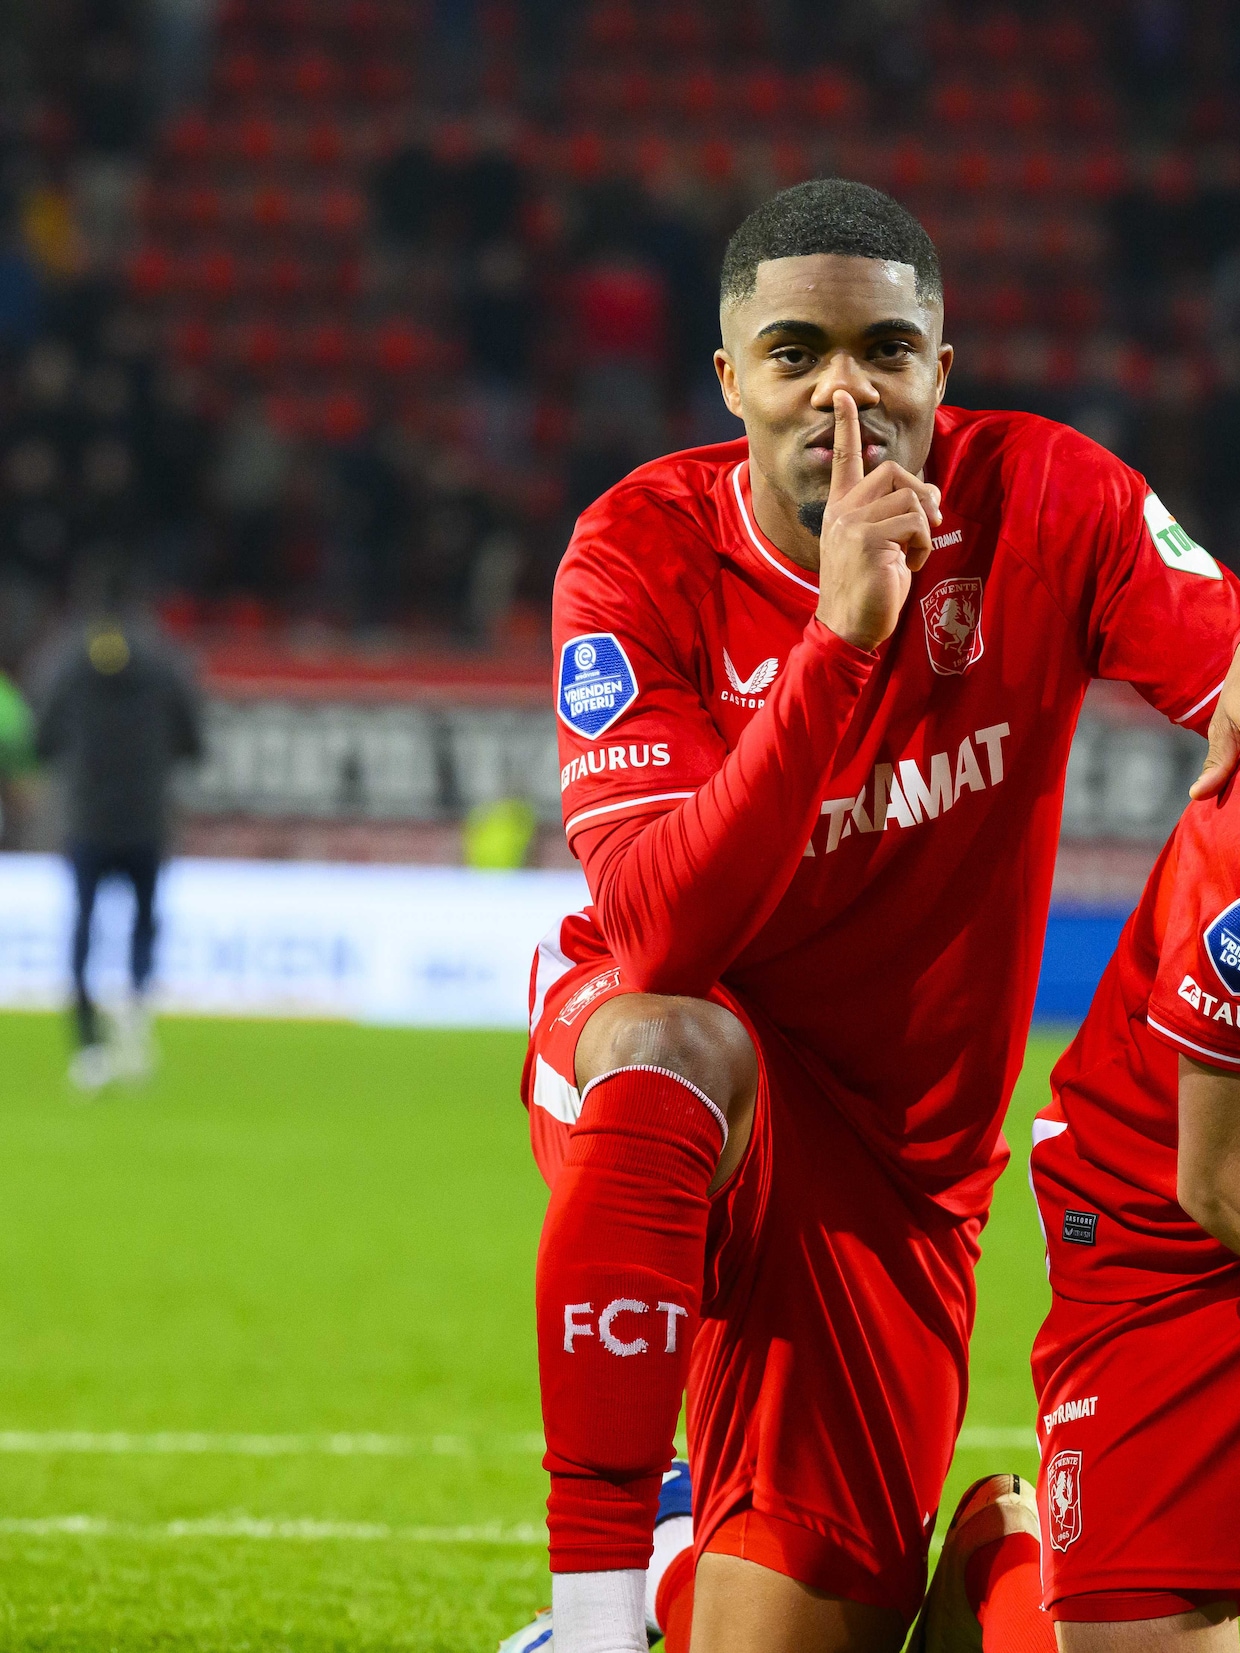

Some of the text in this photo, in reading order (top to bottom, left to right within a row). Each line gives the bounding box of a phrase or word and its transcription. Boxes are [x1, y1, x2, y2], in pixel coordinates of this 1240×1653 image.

[931, 529, 963, 551] TRAMAT
[1156, 523, 1198, 558] TO
[934, 583, 978, 599] TWENTE
[565, 680, 623, 706] VRIENDEN
[570, 694, 616, 718] LOTERIJ
[569, 743, 671, 783] TAURUS
[1065, 1215, 1093, 1226] CASTORE
[563, 1297, 689, 1358] FCT
[1057, 1531, 1071, 1543] 1965
